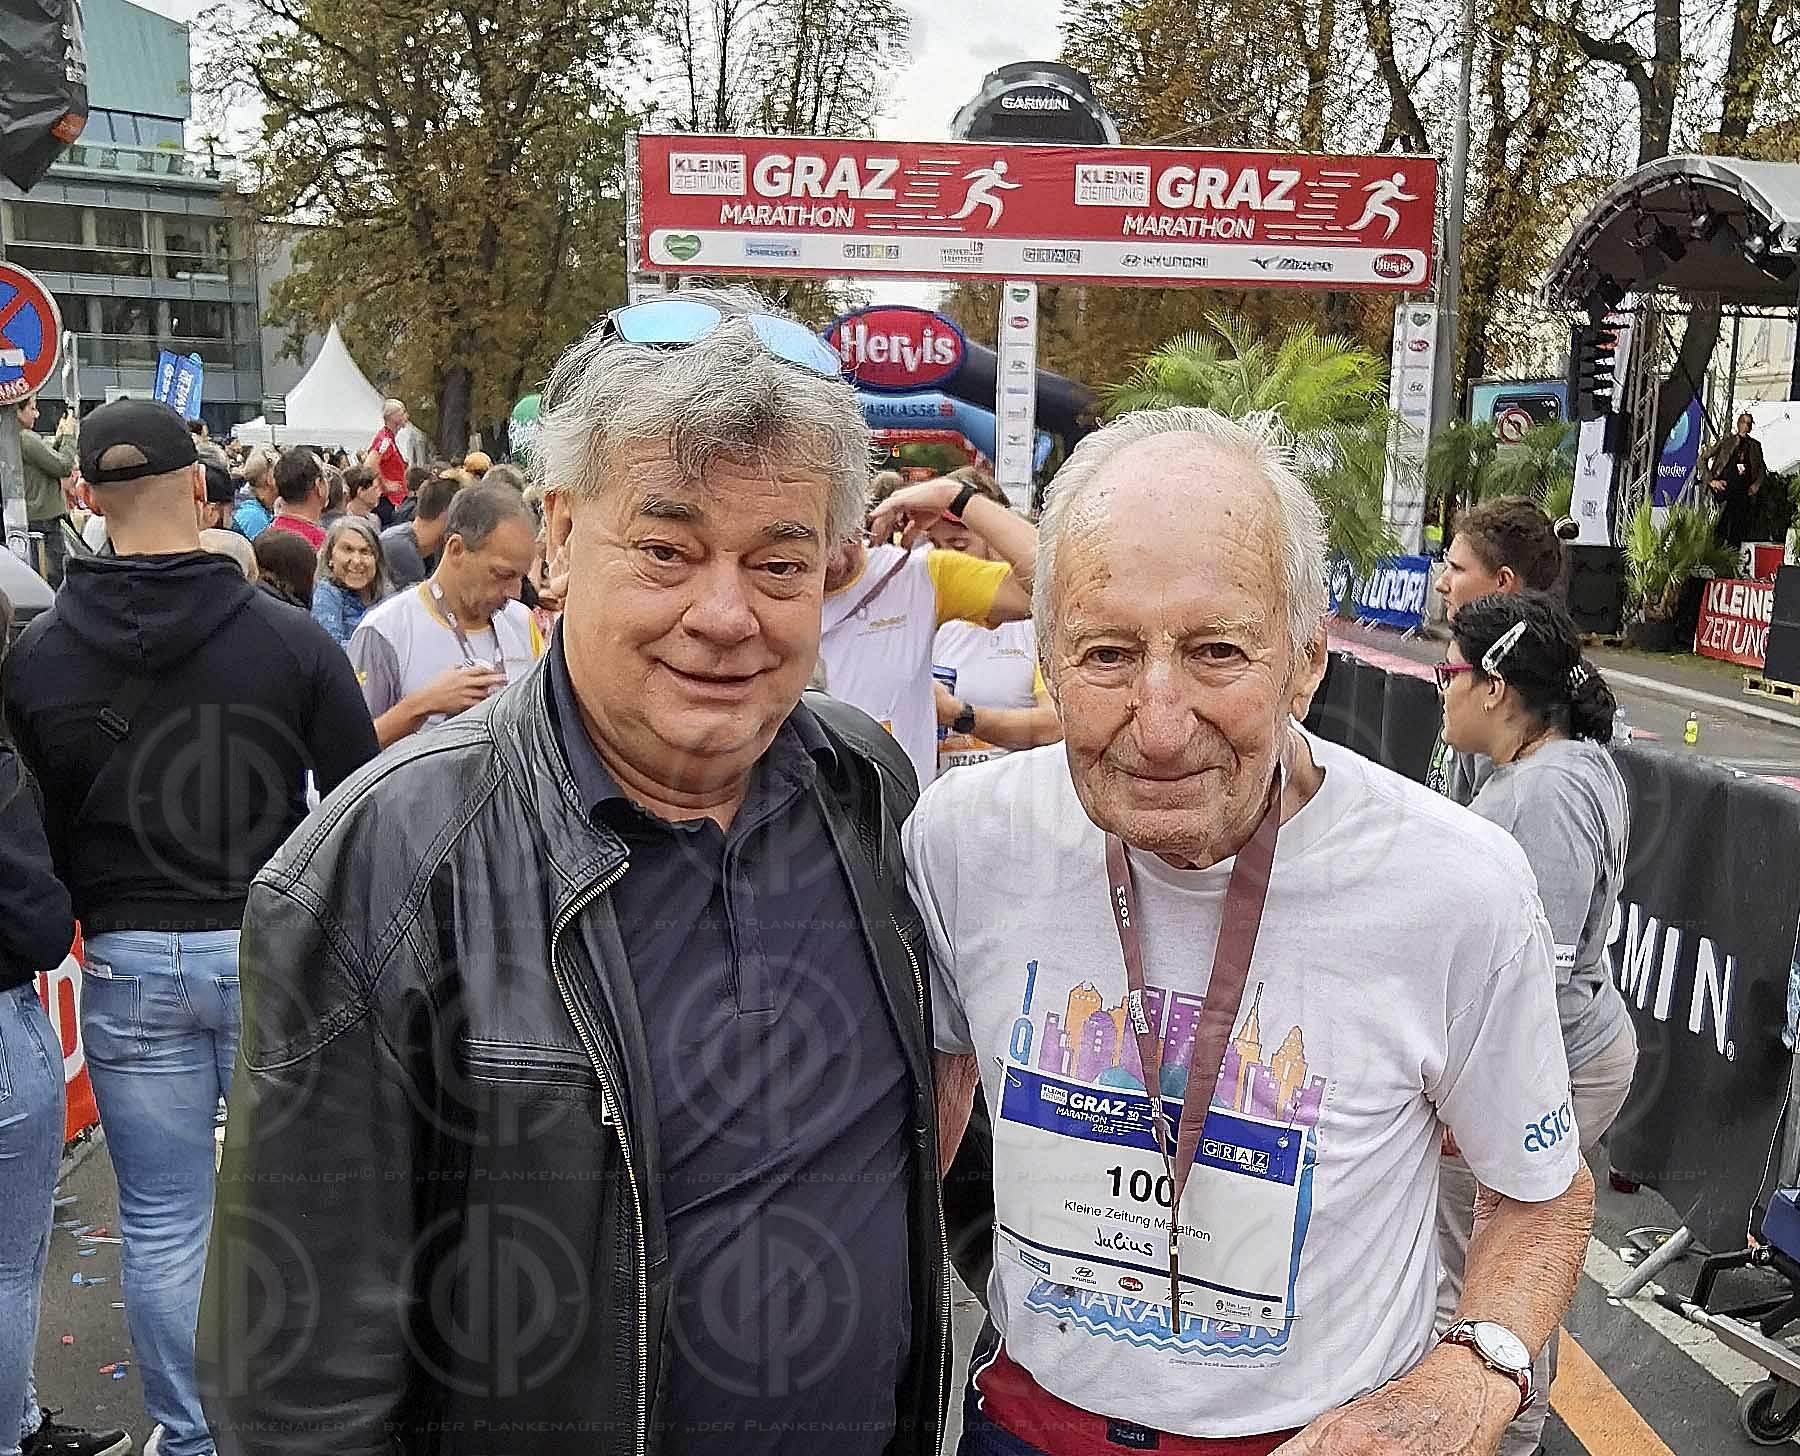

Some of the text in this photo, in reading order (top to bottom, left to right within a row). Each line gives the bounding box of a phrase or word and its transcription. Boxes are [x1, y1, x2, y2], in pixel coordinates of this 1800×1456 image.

[1001, 95, 1071, 111] GARMIN
[674, 158, 740, 174] KLEINE
[753, 154, 900, 200] GRAZ
[1080, 169, 1145, 185] KLEINE
[674, 174, 740, 190] ZEITUNG
[1157, 166, 1301, 212] GRAZ
[720, 203, 856, 228] MARATHON
[1122, 214, 1255, 240] MARATHON
[1024, 247, 1081, 264] GRAZ
[840, 321, 956, 372] Hervis
[1707, 581, 1774, 623] KLEINE
[1056, 1107, 1107, 1124] MARATHON
[1070, 1093, 1127, 1117] GRAZ
[1092, 1123, 1115, 1134] 2023
[1203, 1139, 1269, 1169] GRAZ
[1107, 1166, 1175, 1207] 100
[1064, 1200, 1211, 1242] Kleine Zeitung Maathon
[1094, 1225, 1153, 1257] Julius
